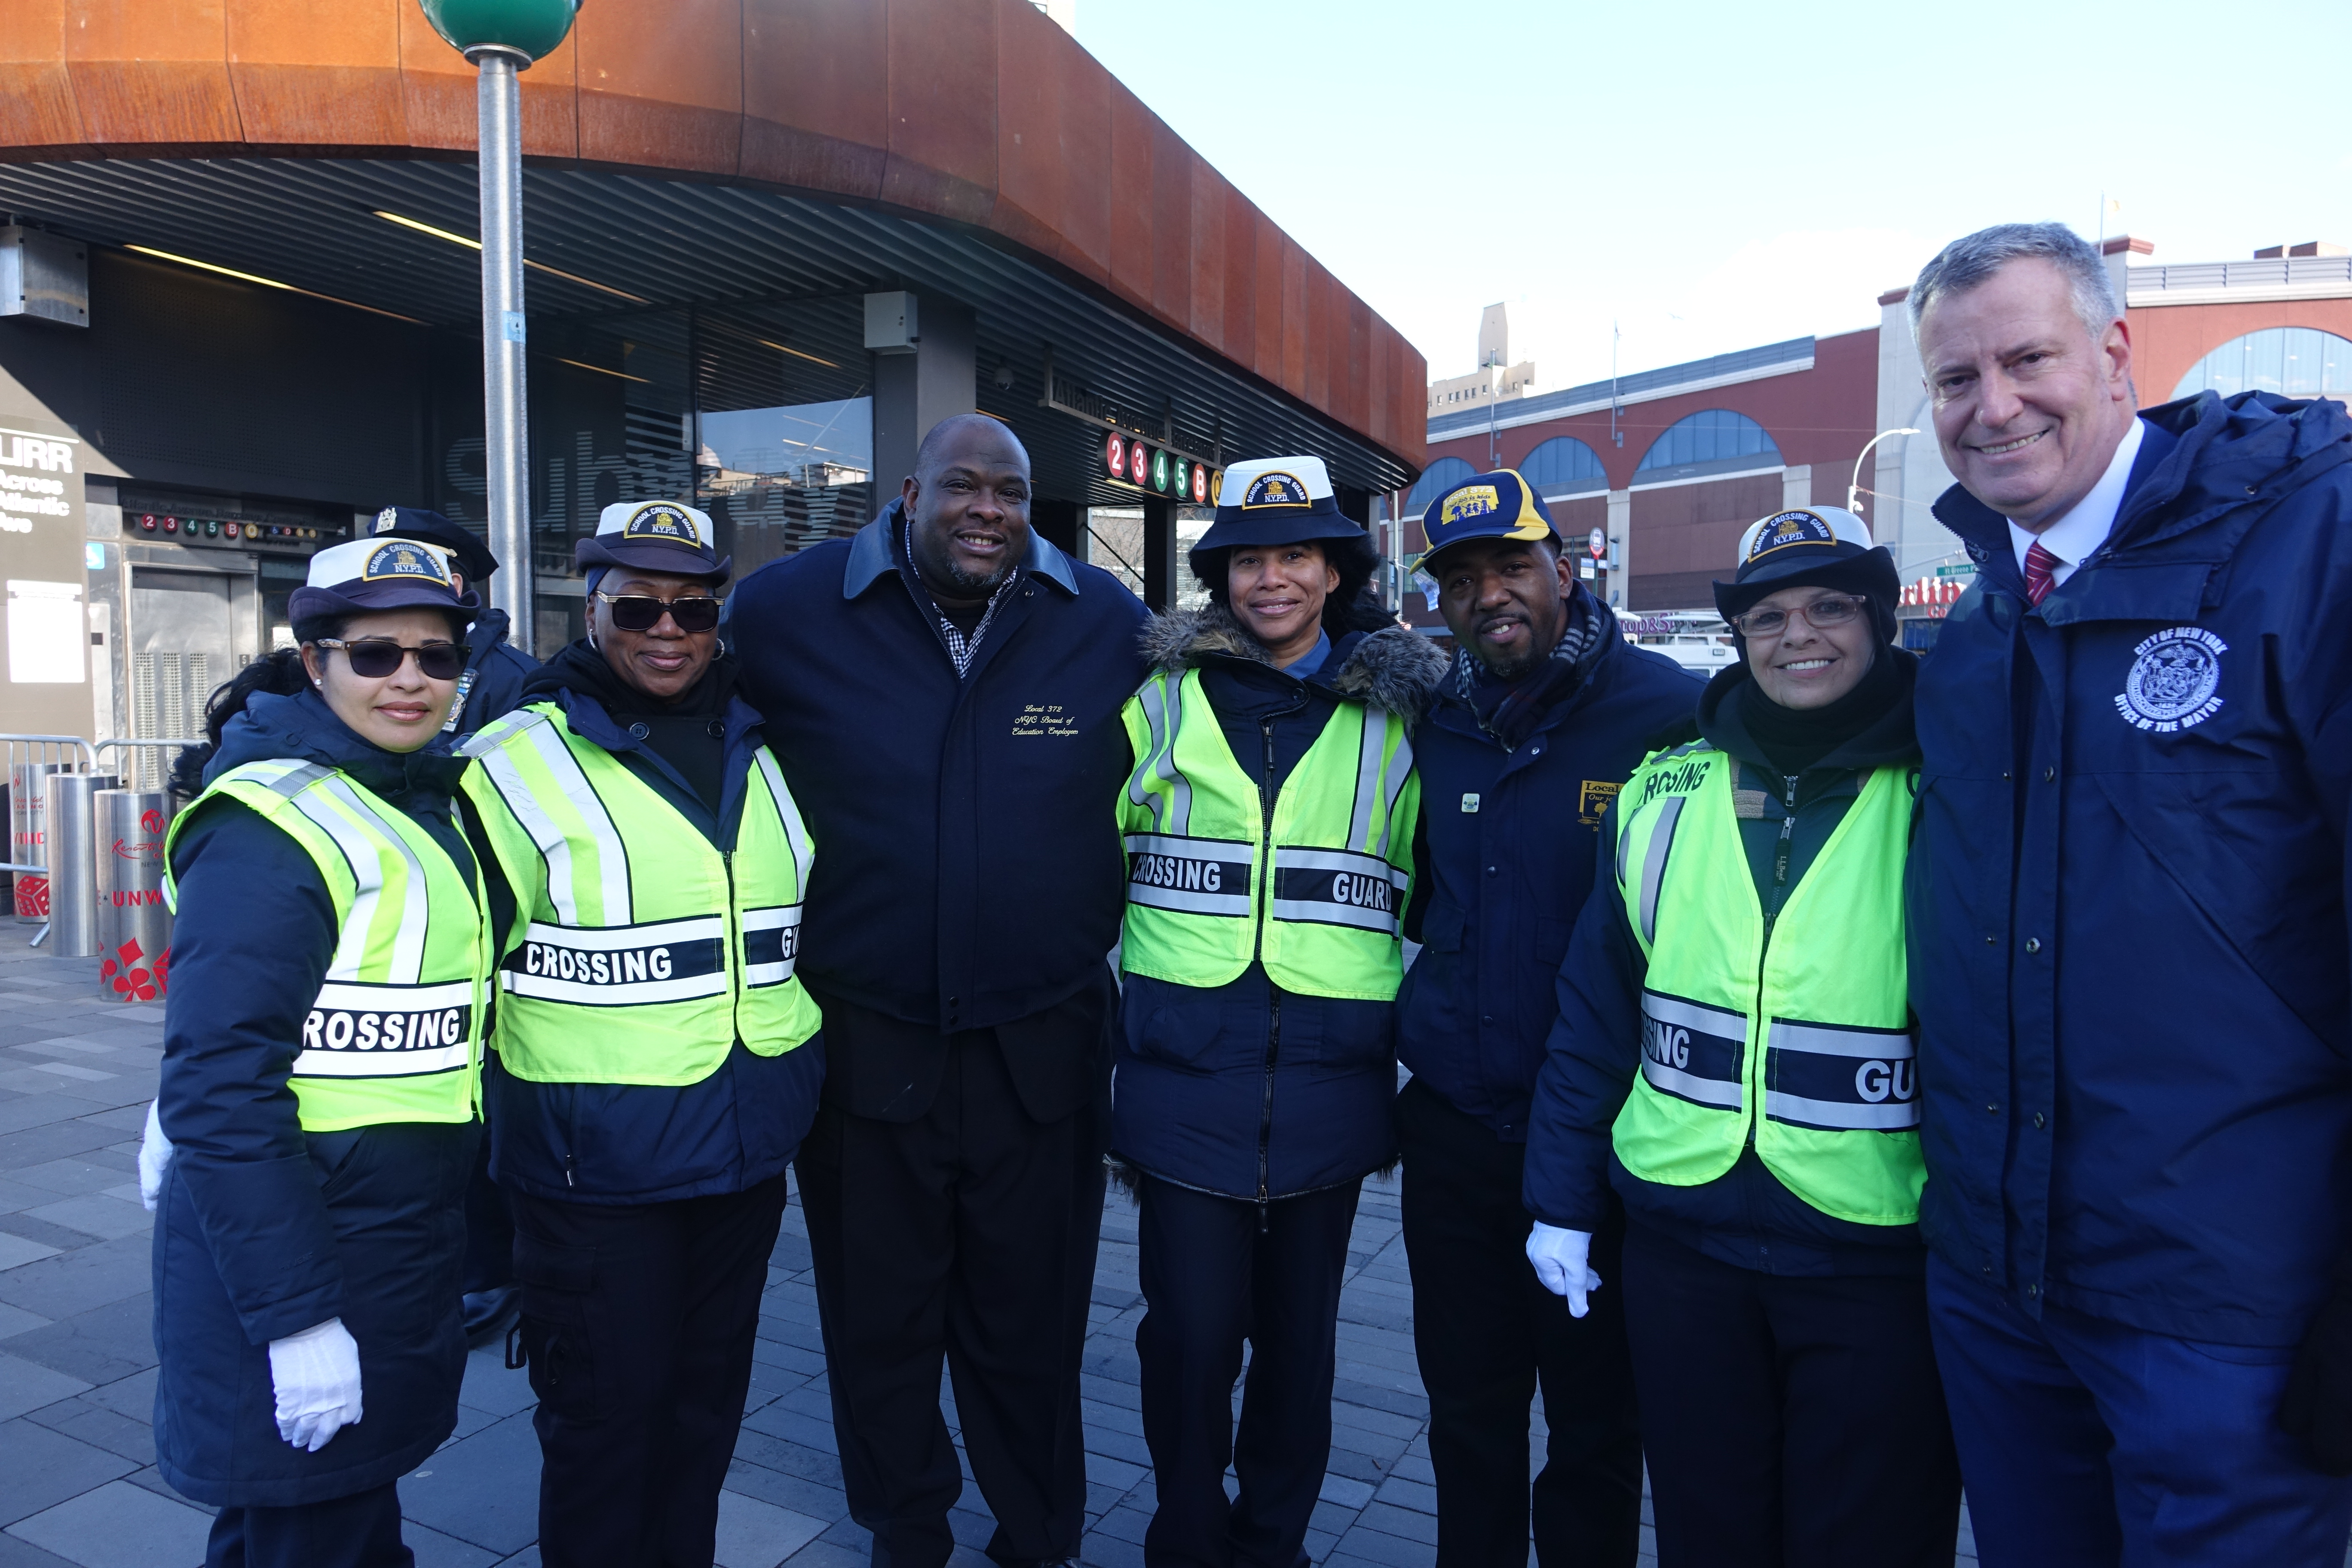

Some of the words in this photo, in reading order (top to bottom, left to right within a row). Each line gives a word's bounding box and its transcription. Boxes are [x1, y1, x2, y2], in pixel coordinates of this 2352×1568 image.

[1112, 440, 1121, 470] 2
[1135, 448, 1144, 477] 3
[1157, 457, 1165, 484] 4
[1178, 463, 1185, 490] 5
[1196, 469, 1204, 496] B
[1247, 481, 1262, 503] SCHOOL
[1263, 475, 1291, 484] CROSSING
[1292, 482, 1305, 500] GUARD
[1444, 489, 1468, 506] Local
[146, 516, 153, 527] 2
[168, 518, 175, 529] 3
[188, 520, 195, 530] 4
[209, 522, 216, 533] 5
[229, 524, 236, 534] B
[631, 511, 651, 532] SCHOOL
[650, 507, 683, 519] CROSSING
[682, 518, 695, 539] GUARD
[1753, 528, 1770, 553] SCHOOL
[1770, 513, 1809, 527] CROSSING
[1810, 518, 1829, 537] GUARD
[370, 550, 389, 573] SCHOOL
[389, 545, 425, 556] CROSSING
[426, 555, 443, 576] GUARD
[2133, 634, 2158, 655] CITY
[2159, 628, 2174, 641] OF
[2174, 627, 2203, 639] NEW
[2200, 630, 2228, 655] YORK
[1014, 716, 1037, 725] NYC
[1066, 717, 1075, 725] of
[2114, 693, 2141, 723] OFFICE
[2136, 717, 2154, 730] OF
[2155, 721, 2178, 732] THE
[2181, 696, 2223, 728] MAYOR
[1048, 727, 1078, 737] Employees
[1585, 783, 1619, 792] Local
[1133, 854, 1220, 891] CROSSING
[1332, 873, 1392, 911] GUARD
[527, 943, 672, 984] CROSSING
[782, 925, 800, 958] GU
[1856, 1059, 1915, 1102] GU
